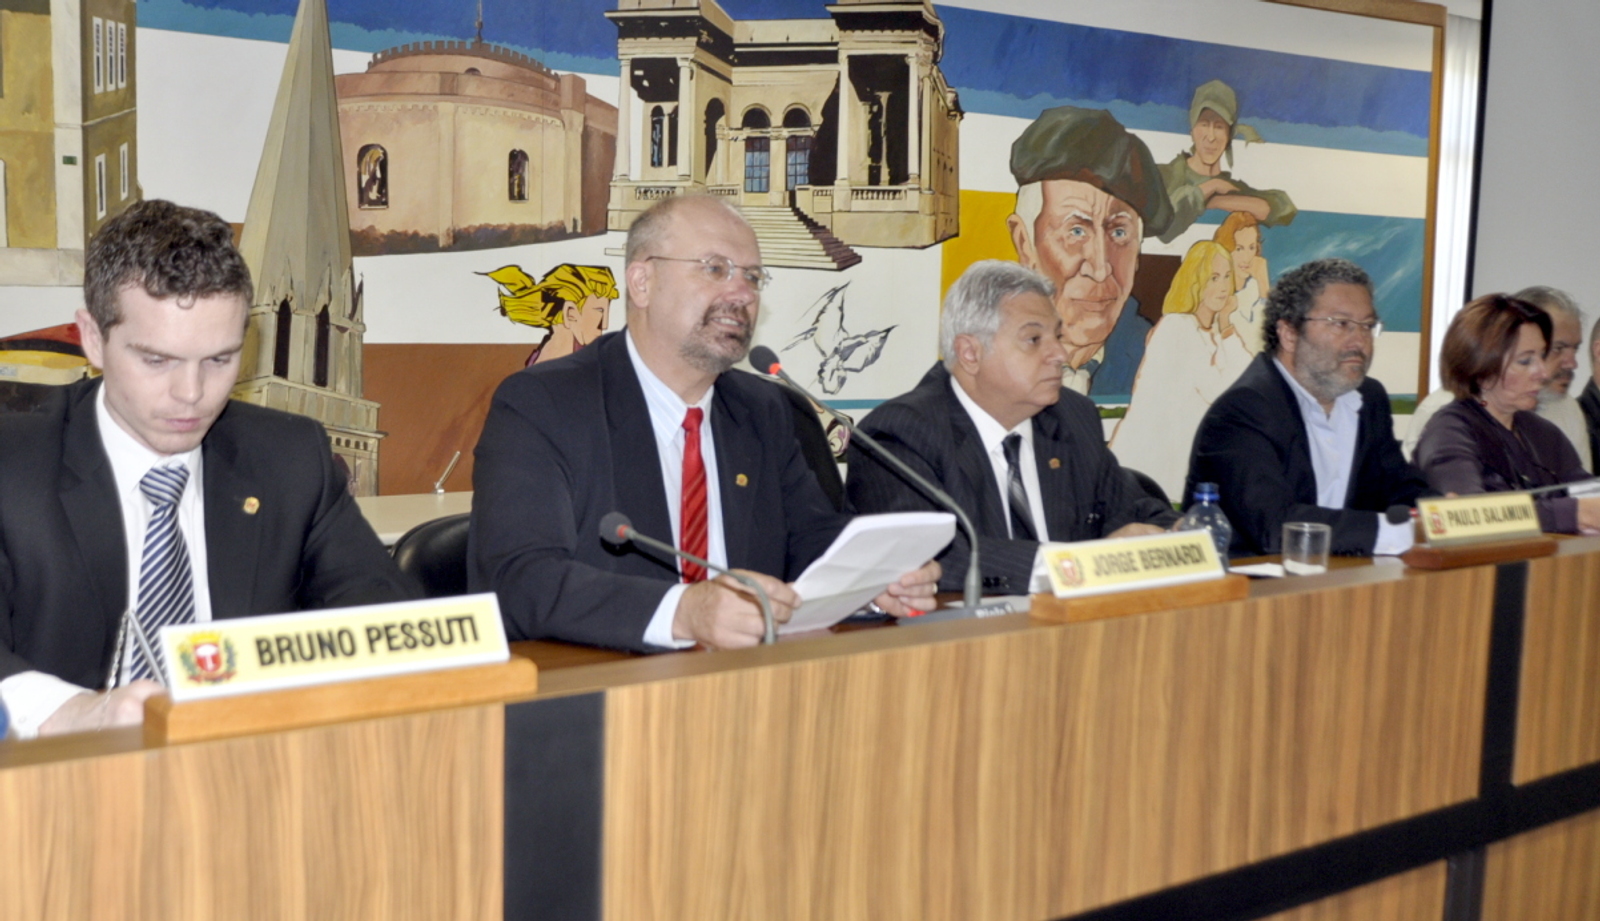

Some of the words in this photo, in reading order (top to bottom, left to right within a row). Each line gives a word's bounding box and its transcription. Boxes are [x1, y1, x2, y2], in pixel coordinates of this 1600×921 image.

[1447, 507, 1481, 526] PAULO
[1484, 504, 1534, 524] SALAMUNI
[1093, 551, 1140, 576] JORGE
[1139, 542, 1207, 570] BERNARDI
[256, 627, 357, 666] BRUNO
[366, 613, 480, 653] PESSUTI
